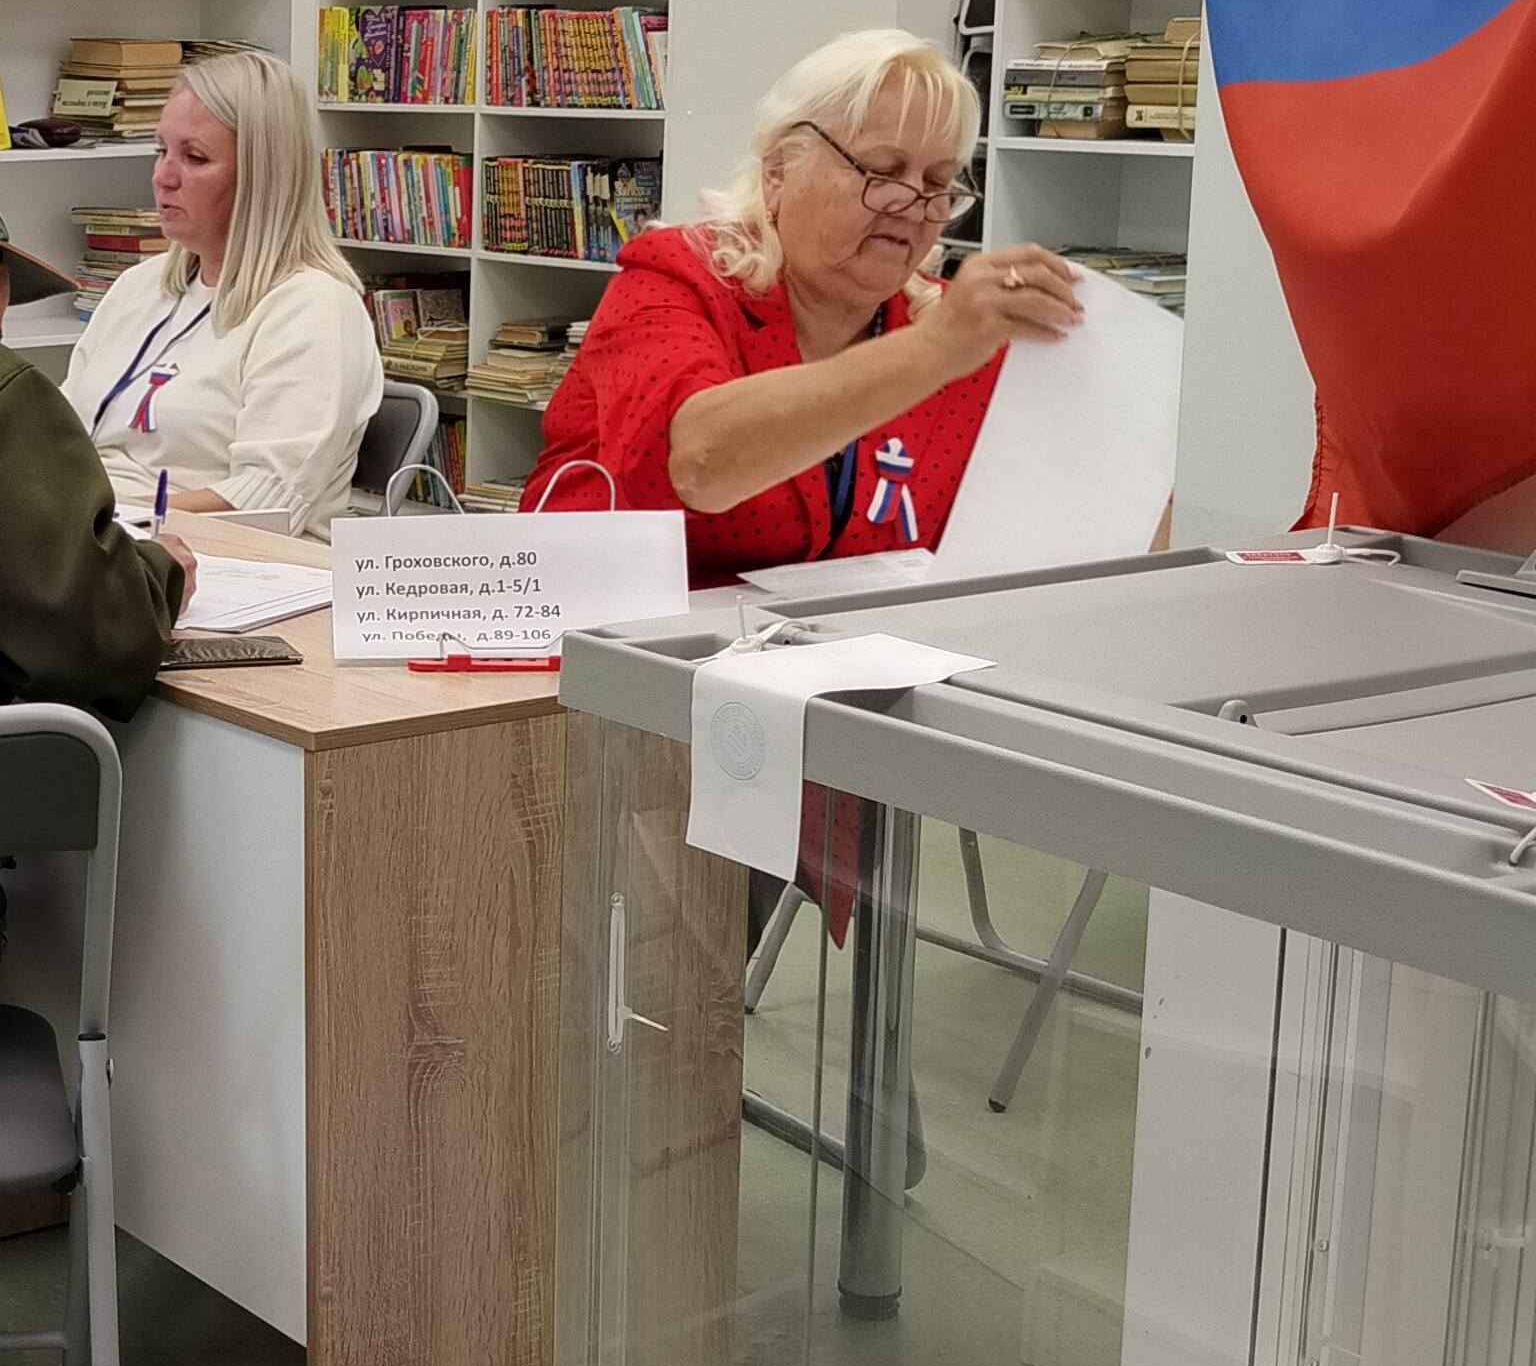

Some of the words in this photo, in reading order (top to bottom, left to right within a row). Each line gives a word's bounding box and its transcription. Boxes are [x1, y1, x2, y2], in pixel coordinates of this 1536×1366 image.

[355, 556, 380, 571] ул.
[385, 554, 494, 570] Гроховского,
[500, 551, 537, 569] д.80
[356, 583, 380, 598] ул.
[385, 581, 475, 597] Кедровая,
[479, 577, 541, 596] д.1-5/1
[356, 609, 380, 623] ул.
[386, 606, 486, 622] Кирпичная,
[492, 607, 508, 621] д.
[514, 605, 561, 619] 72-84
[363, 633, 386, 642] ул.
[477, 629, 551, 642] д.89-106
